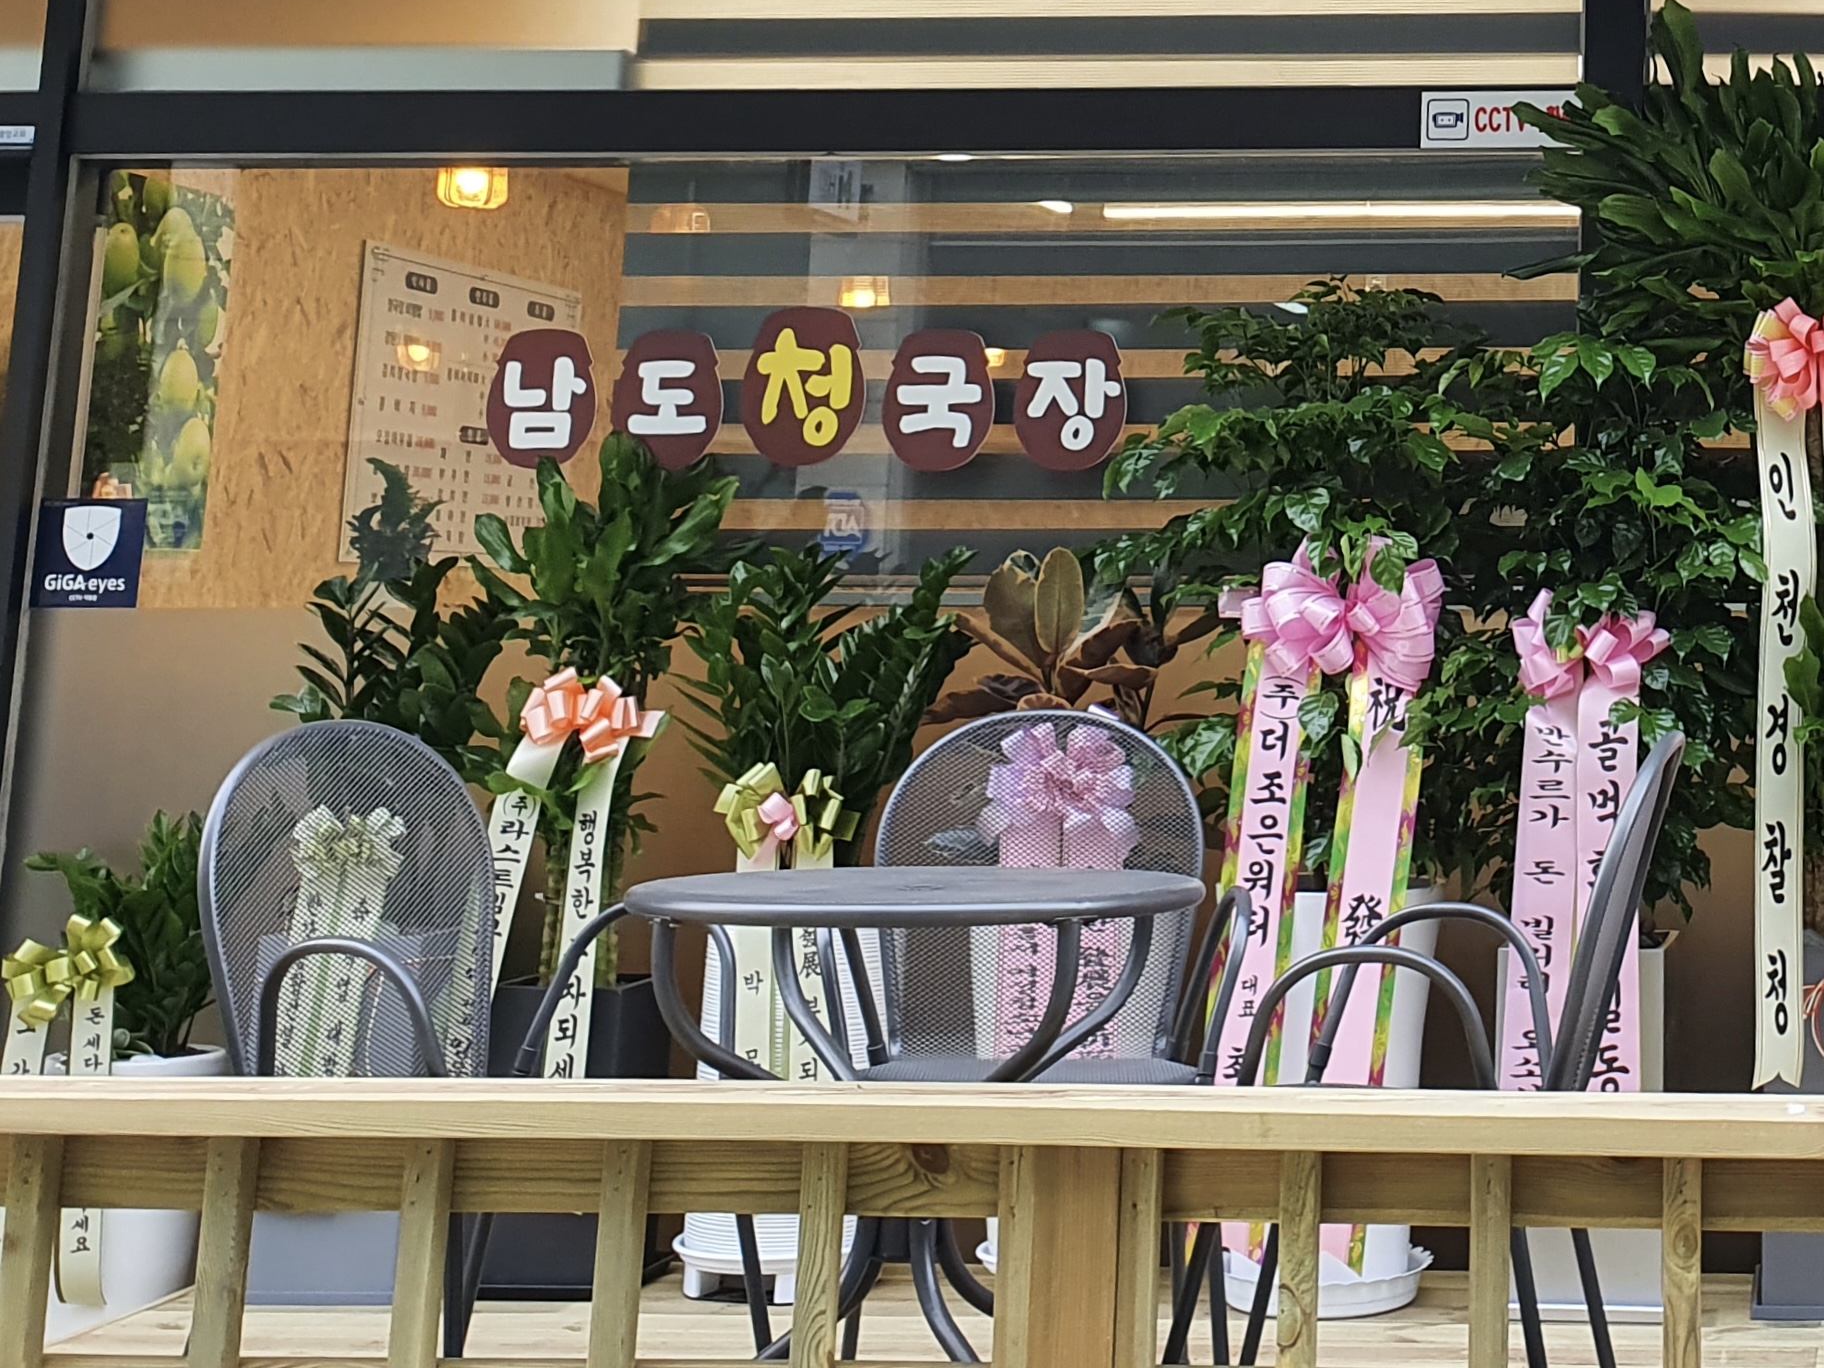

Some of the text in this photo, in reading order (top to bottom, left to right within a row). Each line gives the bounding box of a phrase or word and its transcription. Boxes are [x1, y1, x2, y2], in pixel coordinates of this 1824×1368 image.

[504, 328, 1121, 451] 남도청국장
[1761, 451, 1802, 1035] 인천경찰청
[570, 810, 598, 919] 행복한
